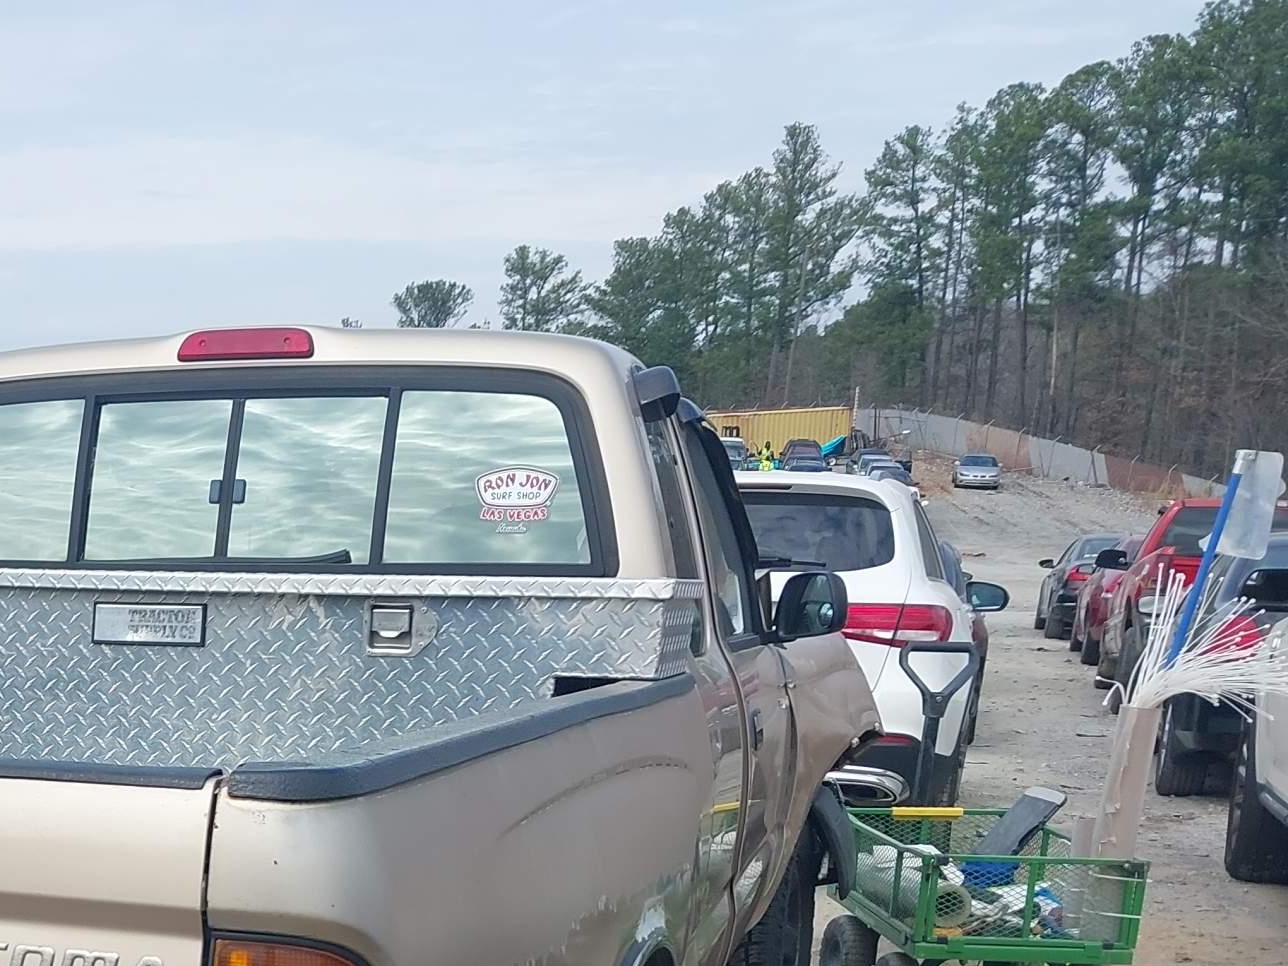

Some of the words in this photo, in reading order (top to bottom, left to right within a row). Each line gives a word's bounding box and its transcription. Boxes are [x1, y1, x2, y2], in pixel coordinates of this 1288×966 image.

[483, 473, 516, 493] RON
[519, 474, 552, 491] JON
[490, 491, 512, 501] SURF
[516, 491, 541, 501] SHOP
[480, 507, 504, 520] LAS
[507, 507, 548, 520] VEGAS
